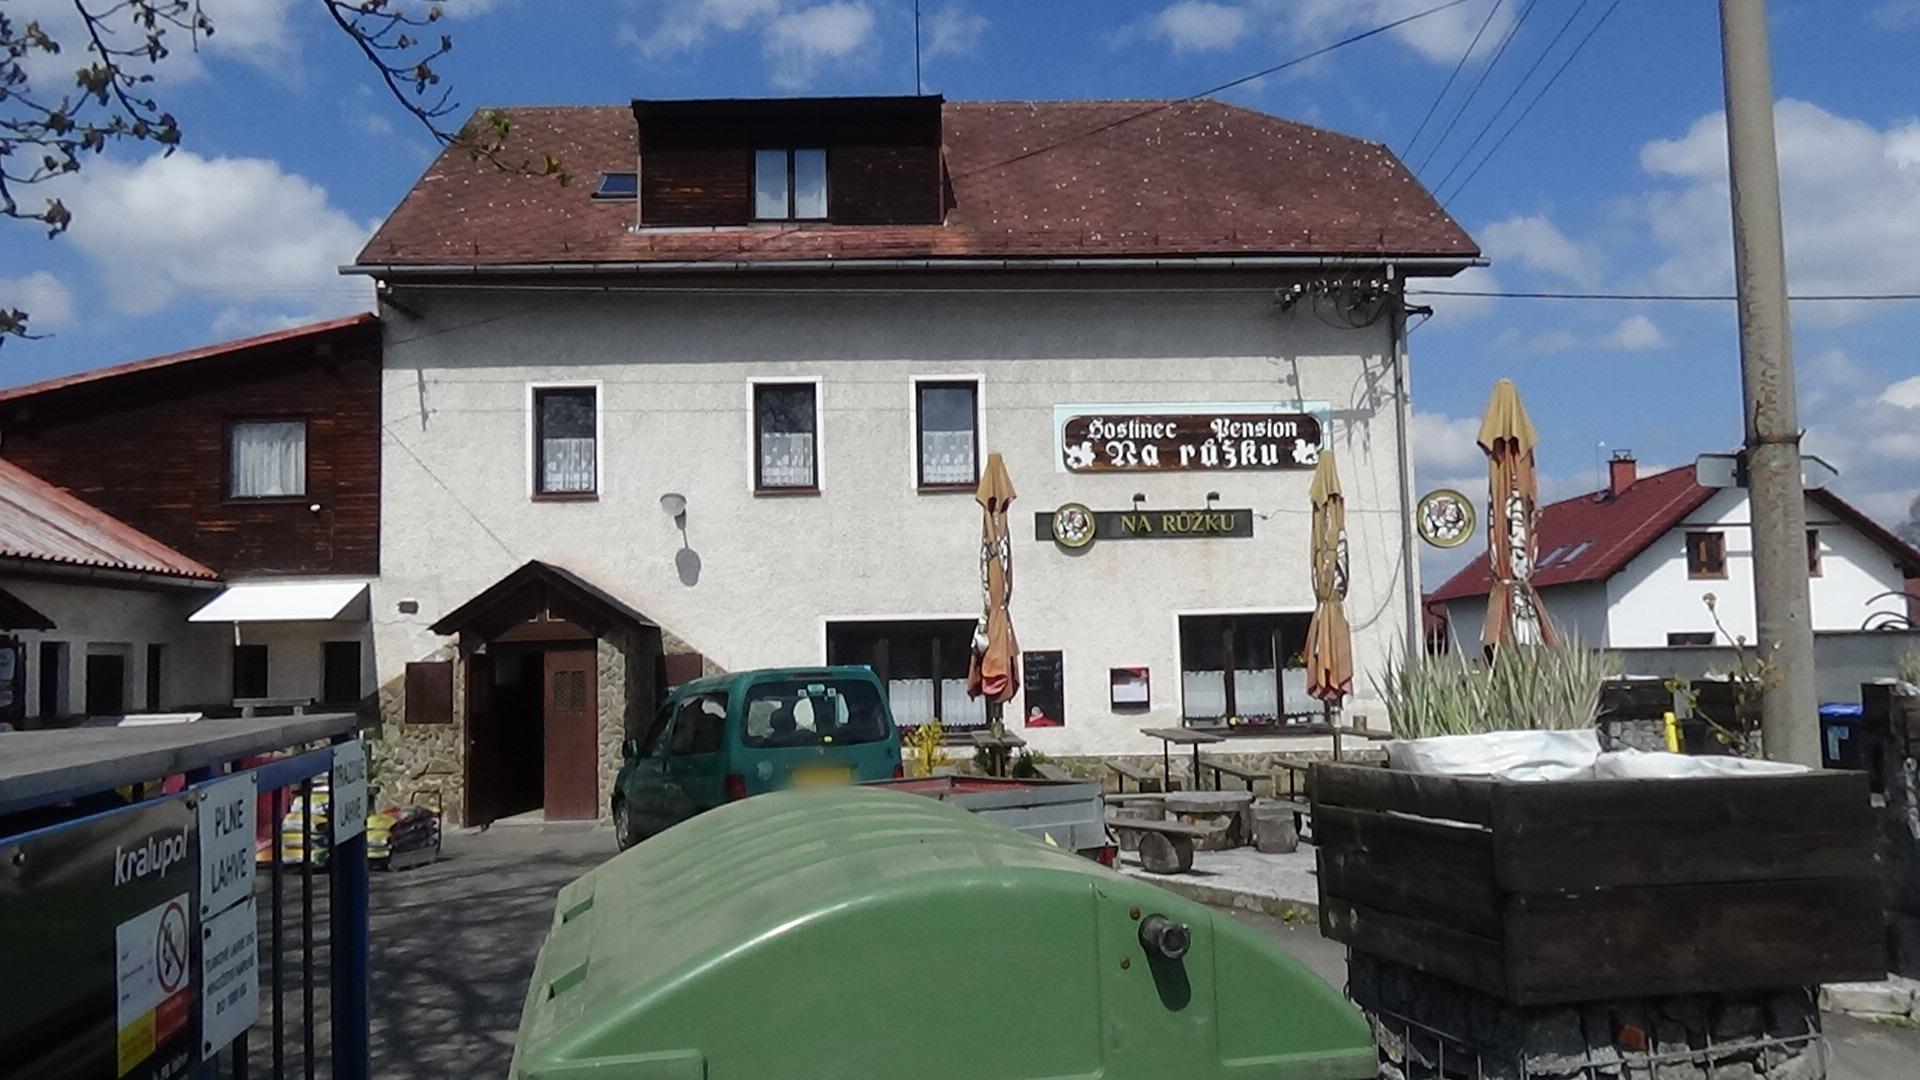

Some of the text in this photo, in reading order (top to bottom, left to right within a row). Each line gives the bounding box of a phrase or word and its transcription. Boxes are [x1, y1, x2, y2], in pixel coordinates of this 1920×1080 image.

[1210, 418, 1298, 441] Pension
[1106, 440, 1159, 467] Na
[1121, 511, 1235, 532] NA RŮŽKU
[114, 825, 188, 886] kralupol
[211, 848, 247, 894] LAHVE
